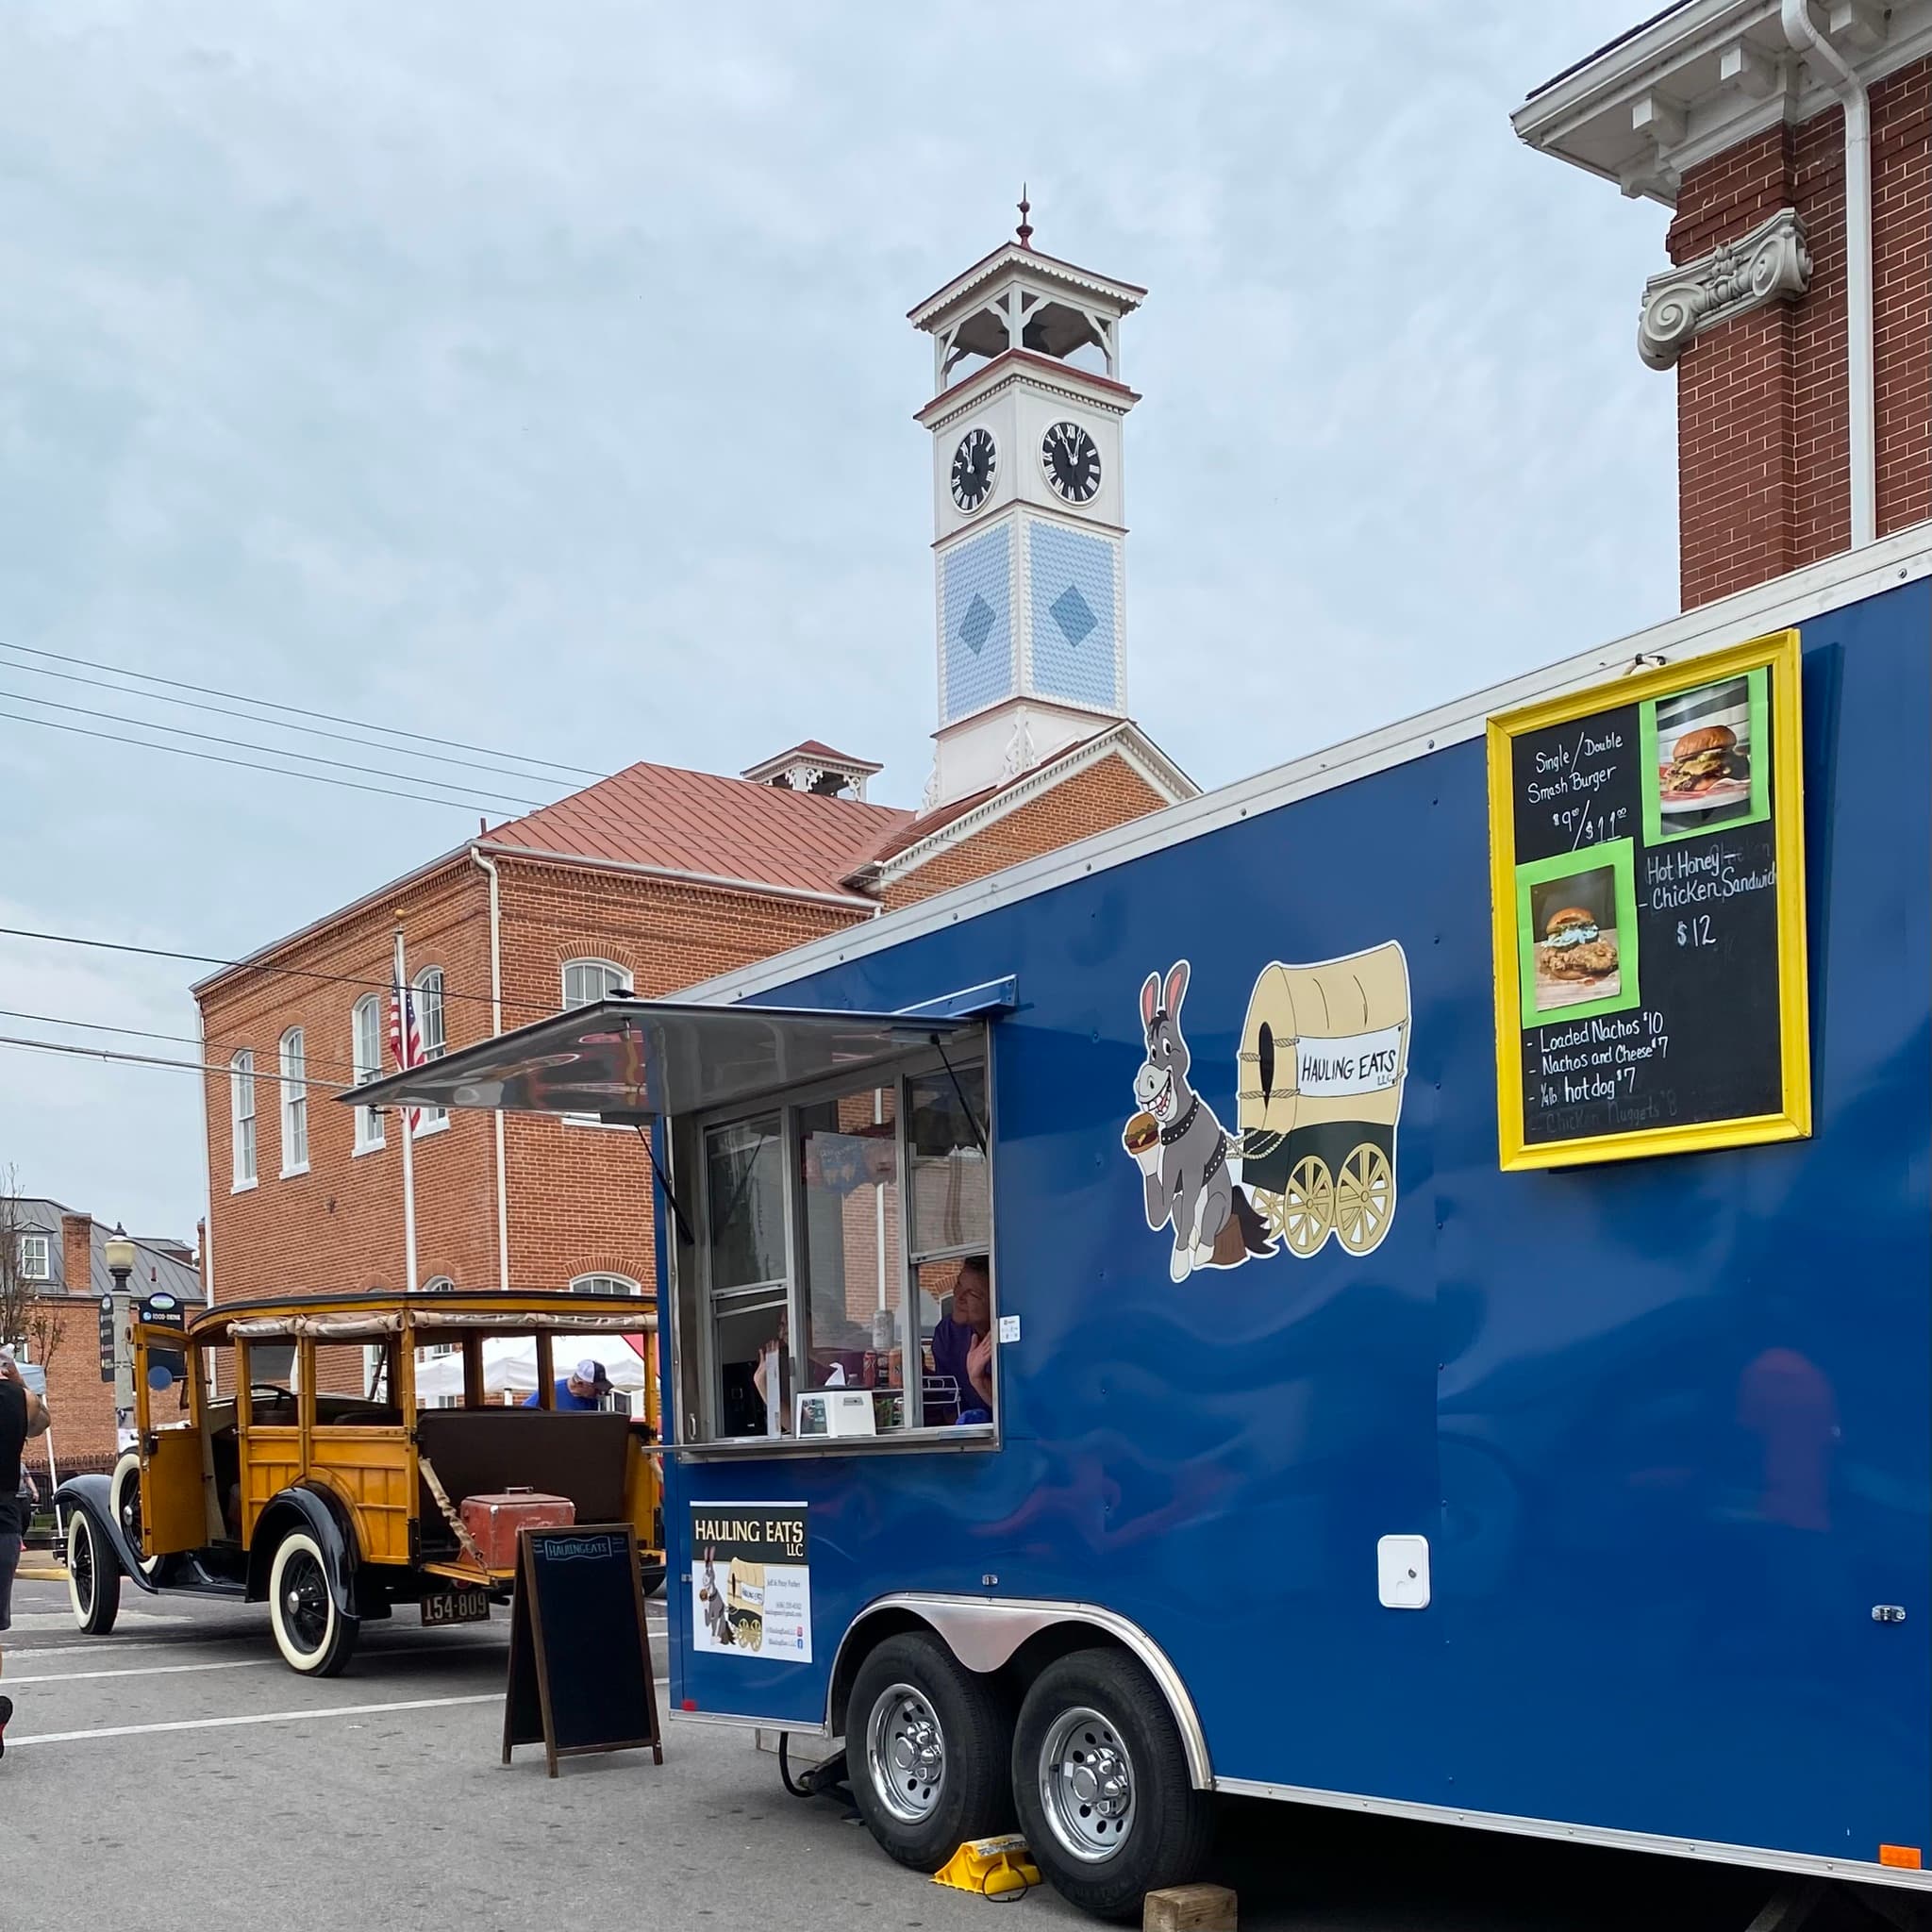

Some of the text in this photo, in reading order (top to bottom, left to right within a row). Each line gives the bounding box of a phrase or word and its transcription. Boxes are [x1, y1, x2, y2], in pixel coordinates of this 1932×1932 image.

[1527, 766, 1617, 804] Smash Burger
[1647, 853, 1674, 885] Hot
[1677, 850, 1720, 876] Honey
[1676, 914, 1717, 946] $12
[1540, 1022, 1590, 1053] Loaded
[1591, 1019, 1640, 1043] Nachos
[1302, 1049, 1396, 1082] HAULING EATS
[1542, 1054, 1588, 1075] Nachos
[1591, 1046, 1612, 1065] and
[1615, 1043, 1653, 1063] Cheese
[1377, 1074, 1391, 1085] LLC
[695, 1520, 803, 1542] HAULING EATS
[787, 1543, 804, 1557] LLC
